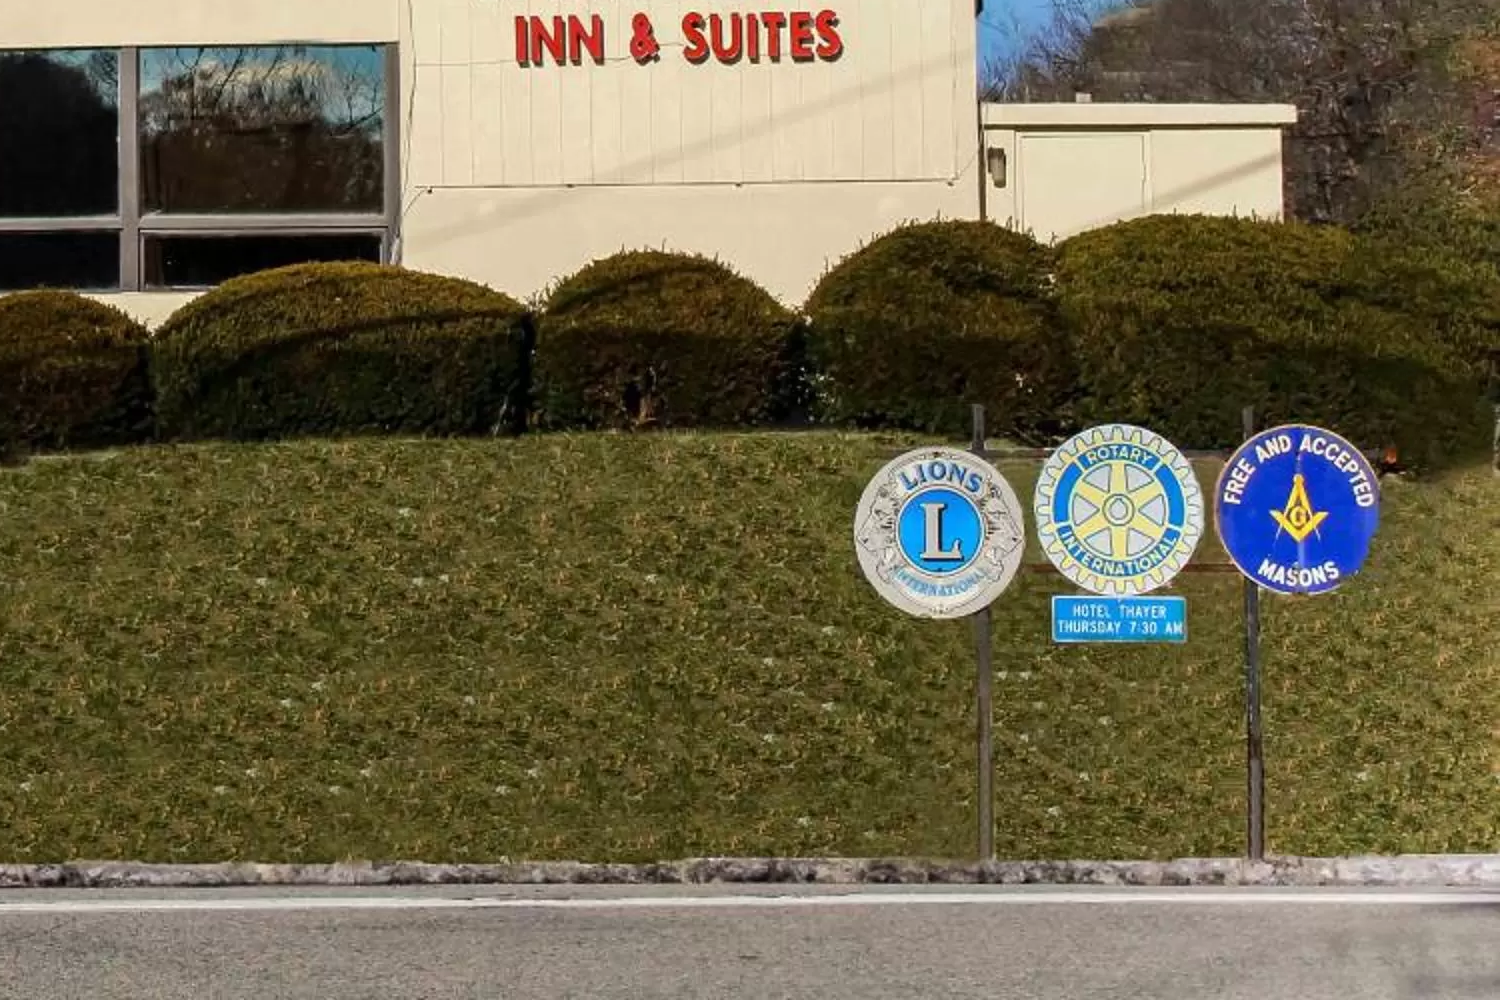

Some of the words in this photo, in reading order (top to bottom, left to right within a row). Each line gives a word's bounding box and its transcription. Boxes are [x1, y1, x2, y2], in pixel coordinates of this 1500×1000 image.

[515, 13, 605, 67] INN
[630, 12, 660, 66] &
[681, 9, 844, 65] SUITES
[1086, 446, 1154, 466] ROTARY
[1223, 458, 1257, 505] FREE
[1254, 435, 1292, 464] AND
[1299, 434, 1375, 507] ACCEPTED
[898, 460, 984, 493] LIONS
[1290, 506, 1308, 527] G
[920, 503, 964, 562] L
[1060, 528, 1178, 576] INTERNATIONAL
[1257, 558, 1340, 587] MASONS
[1072, 604, 1110, 618] HOTEL
[1119, 605, 1167, 619] THAYER
[1058, 620, 1120, 633] THURSDAY
[1165, 621, 1184, 635] AM
